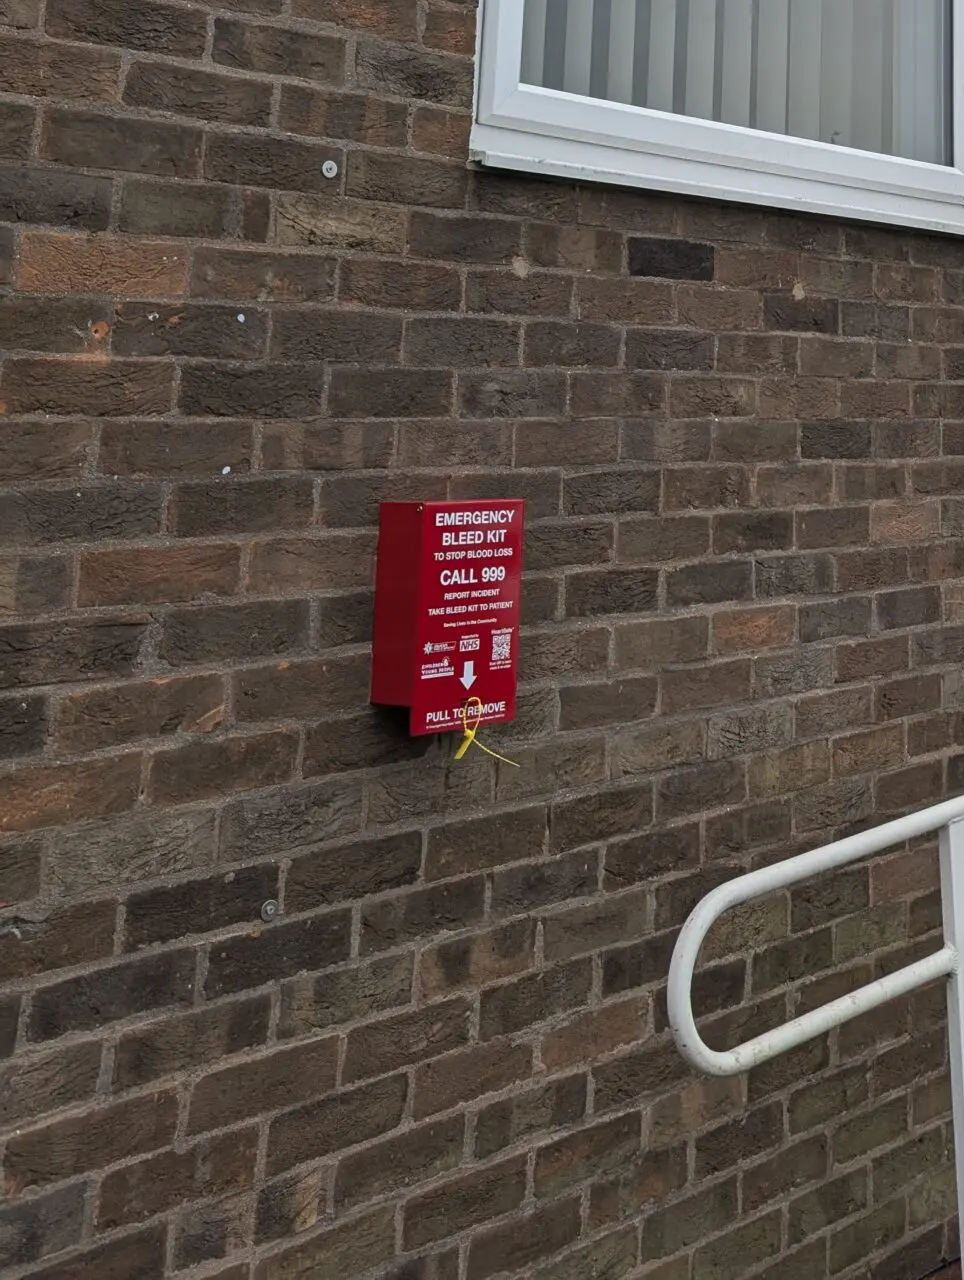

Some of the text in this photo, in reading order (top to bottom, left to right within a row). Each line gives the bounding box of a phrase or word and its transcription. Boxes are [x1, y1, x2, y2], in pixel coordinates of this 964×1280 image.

[435, 510, 514, 526] EMERGENCY
[442, 529, 507, 546] BLEED KIT
[434, 548, 513, 560] TO STOP BLOOD LOSS
[440, 566, 505, 586] CALL 999
[444, 588, 500, 600] REPORT INCIDENT
[428, 601, 513, 616] TAKE BLEED KIT TO PATIENT
[461, 640, 478, 650] NHS
[426, 701, 506, 723] PULL TO REMOVE
